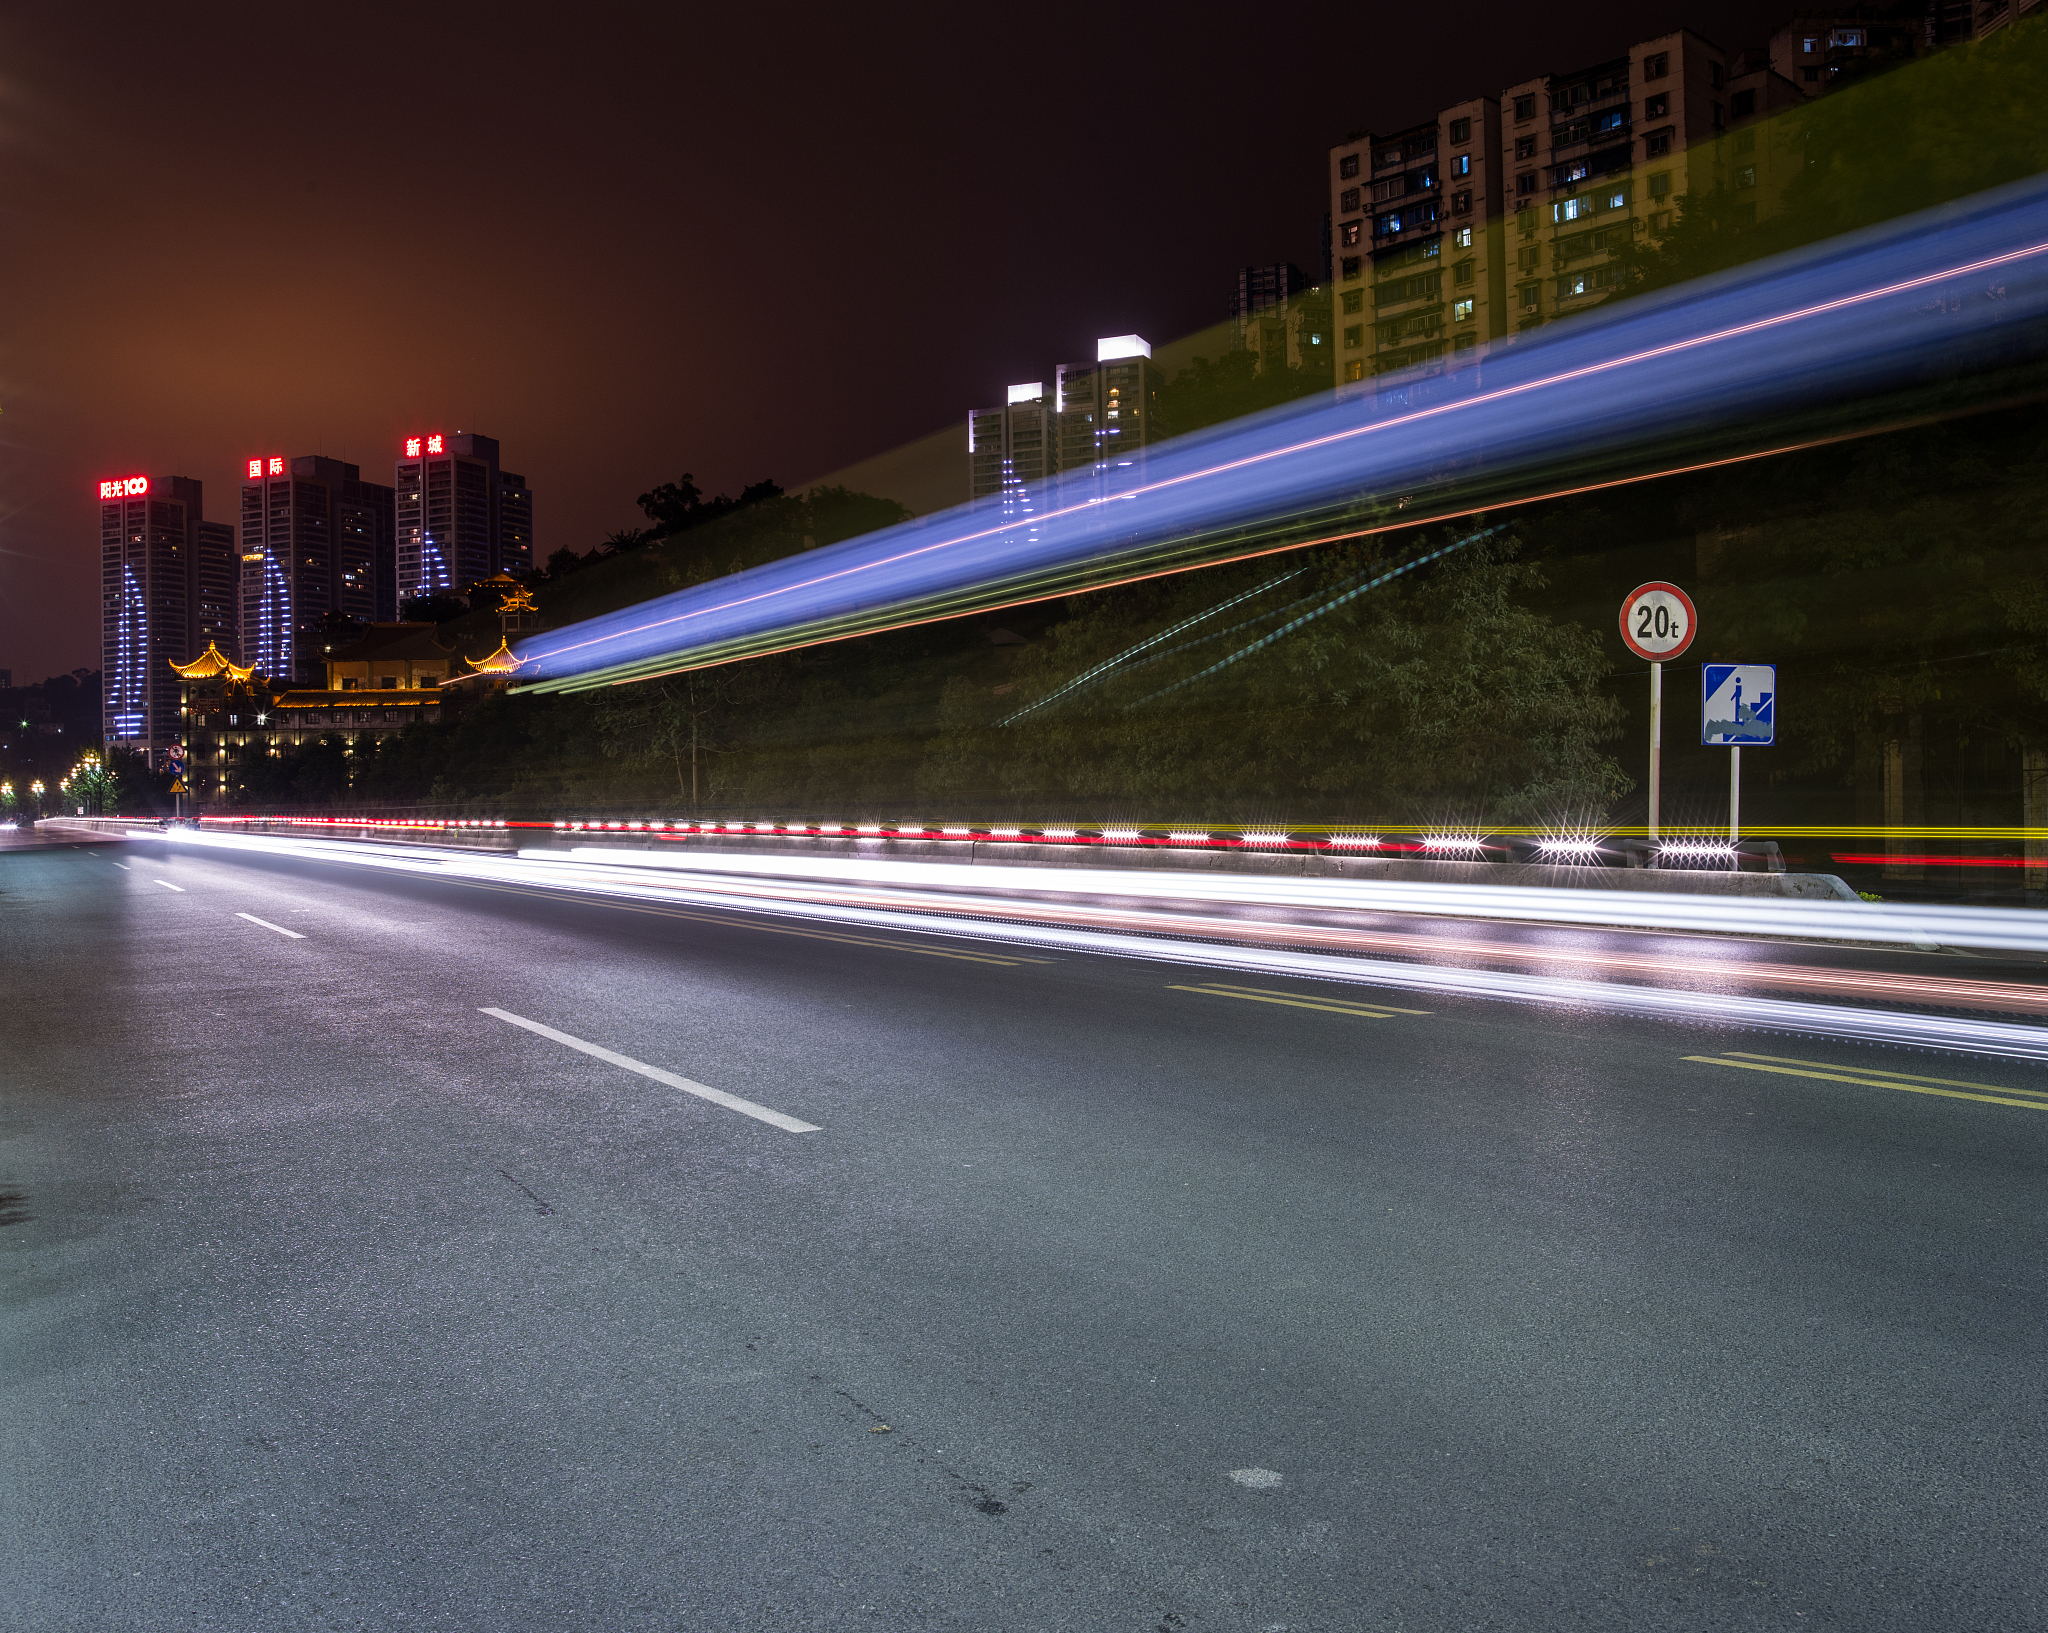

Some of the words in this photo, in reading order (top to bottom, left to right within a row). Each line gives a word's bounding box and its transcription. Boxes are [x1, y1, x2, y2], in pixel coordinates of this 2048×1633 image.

[406, 434, 443, 457] 新城
[249, 457, 283, 479] 国际
[100, 476, 148, 500] 阳光100
[1637, 605, 1679, 639] 20t
